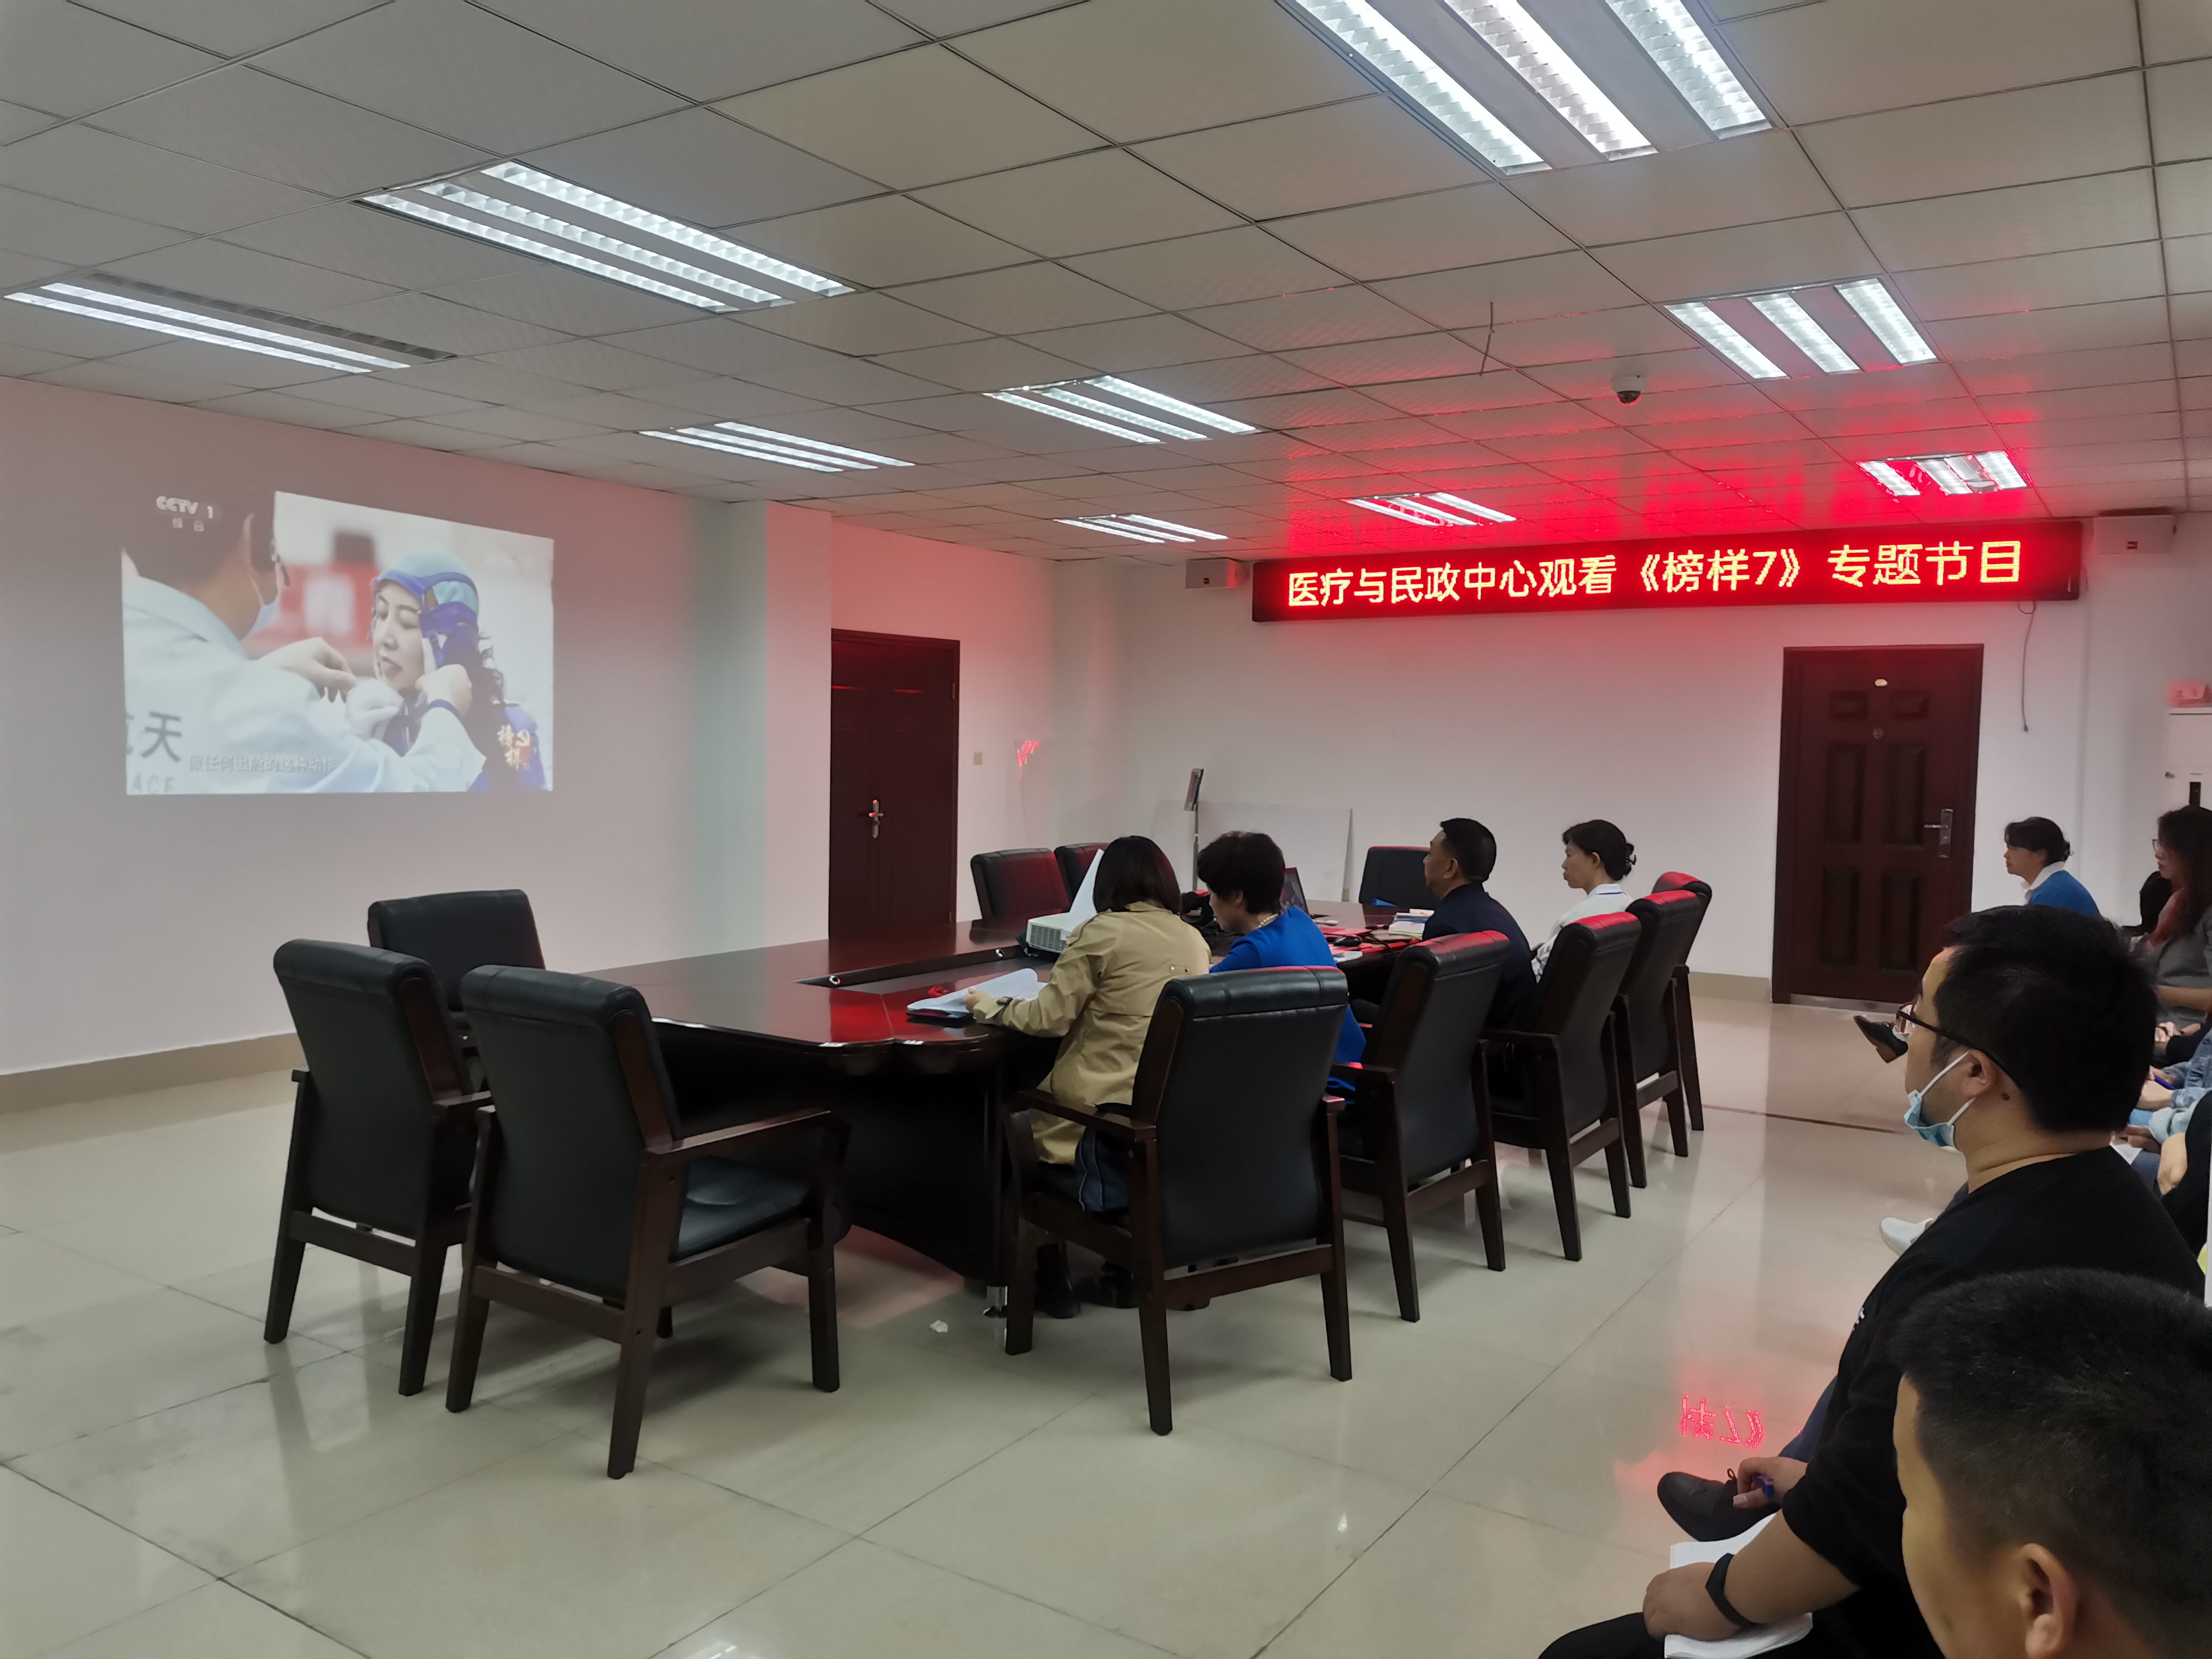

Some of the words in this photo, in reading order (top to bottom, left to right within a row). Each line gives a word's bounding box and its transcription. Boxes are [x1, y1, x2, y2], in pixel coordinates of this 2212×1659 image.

[156, 496, 199, 514] CCTV
[207, 505, 213, 519] 1
[1289, 541, 2021, 606] 医疗与民政中心观看《榜样7》专题节目
[126, 711, 182, 763] 天
